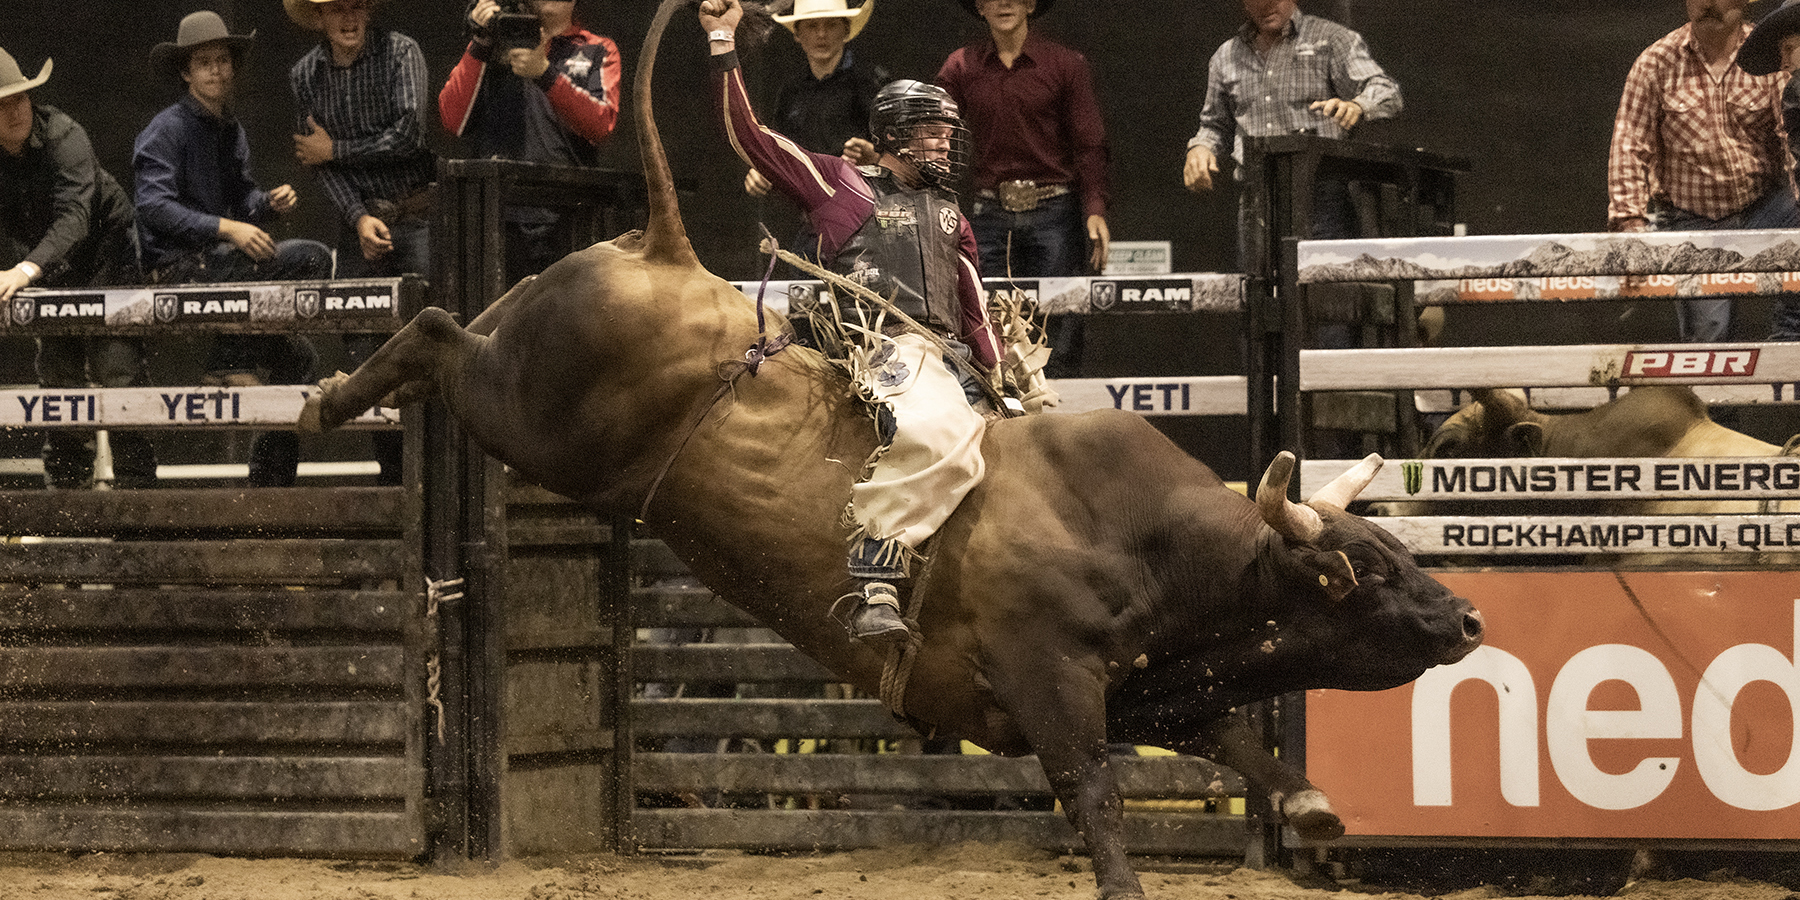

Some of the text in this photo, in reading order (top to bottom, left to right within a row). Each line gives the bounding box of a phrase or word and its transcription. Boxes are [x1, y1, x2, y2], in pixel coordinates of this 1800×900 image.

[184, 299, 249, 314] RAM
[325, 295, 391, 310] RAM
[1121, 288, 1191, 301] RAM
[40, 303, 103, 317] RAM
[1627, 350, 1753, 377] PBR
[17, 396, 95, 422] YETI
[161, 393, 240, 420] YETI
[1106, 383, 1190, 411] YETI
[1432, 463, 1800, 493] MONSTER ENERG
[1443, 524, 1727, 551] ROCKHAMPTON,
[1411, 599, 1800, 812] ned
